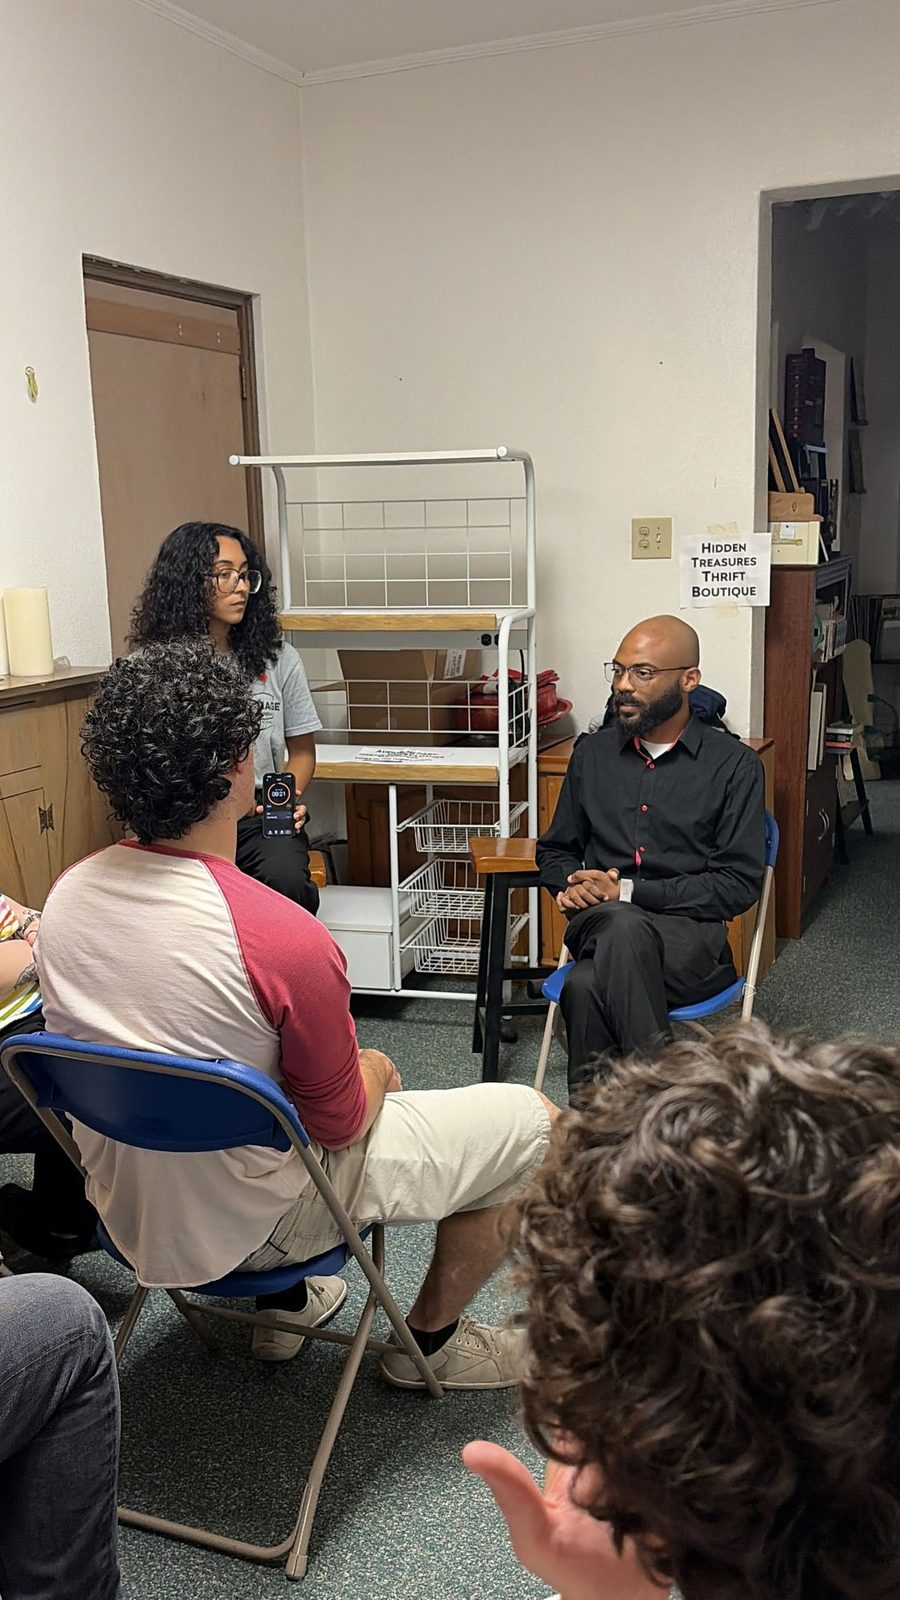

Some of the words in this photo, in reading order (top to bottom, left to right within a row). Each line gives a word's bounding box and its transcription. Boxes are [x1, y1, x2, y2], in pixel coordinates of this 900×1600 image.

[701, 543, 746, 553] HIDDEN
[691, 557, 757, 568] TREASURES
[702, 571, 746, 582] THRIFT
[692, 586, 756, 598] BOUTIQUE
